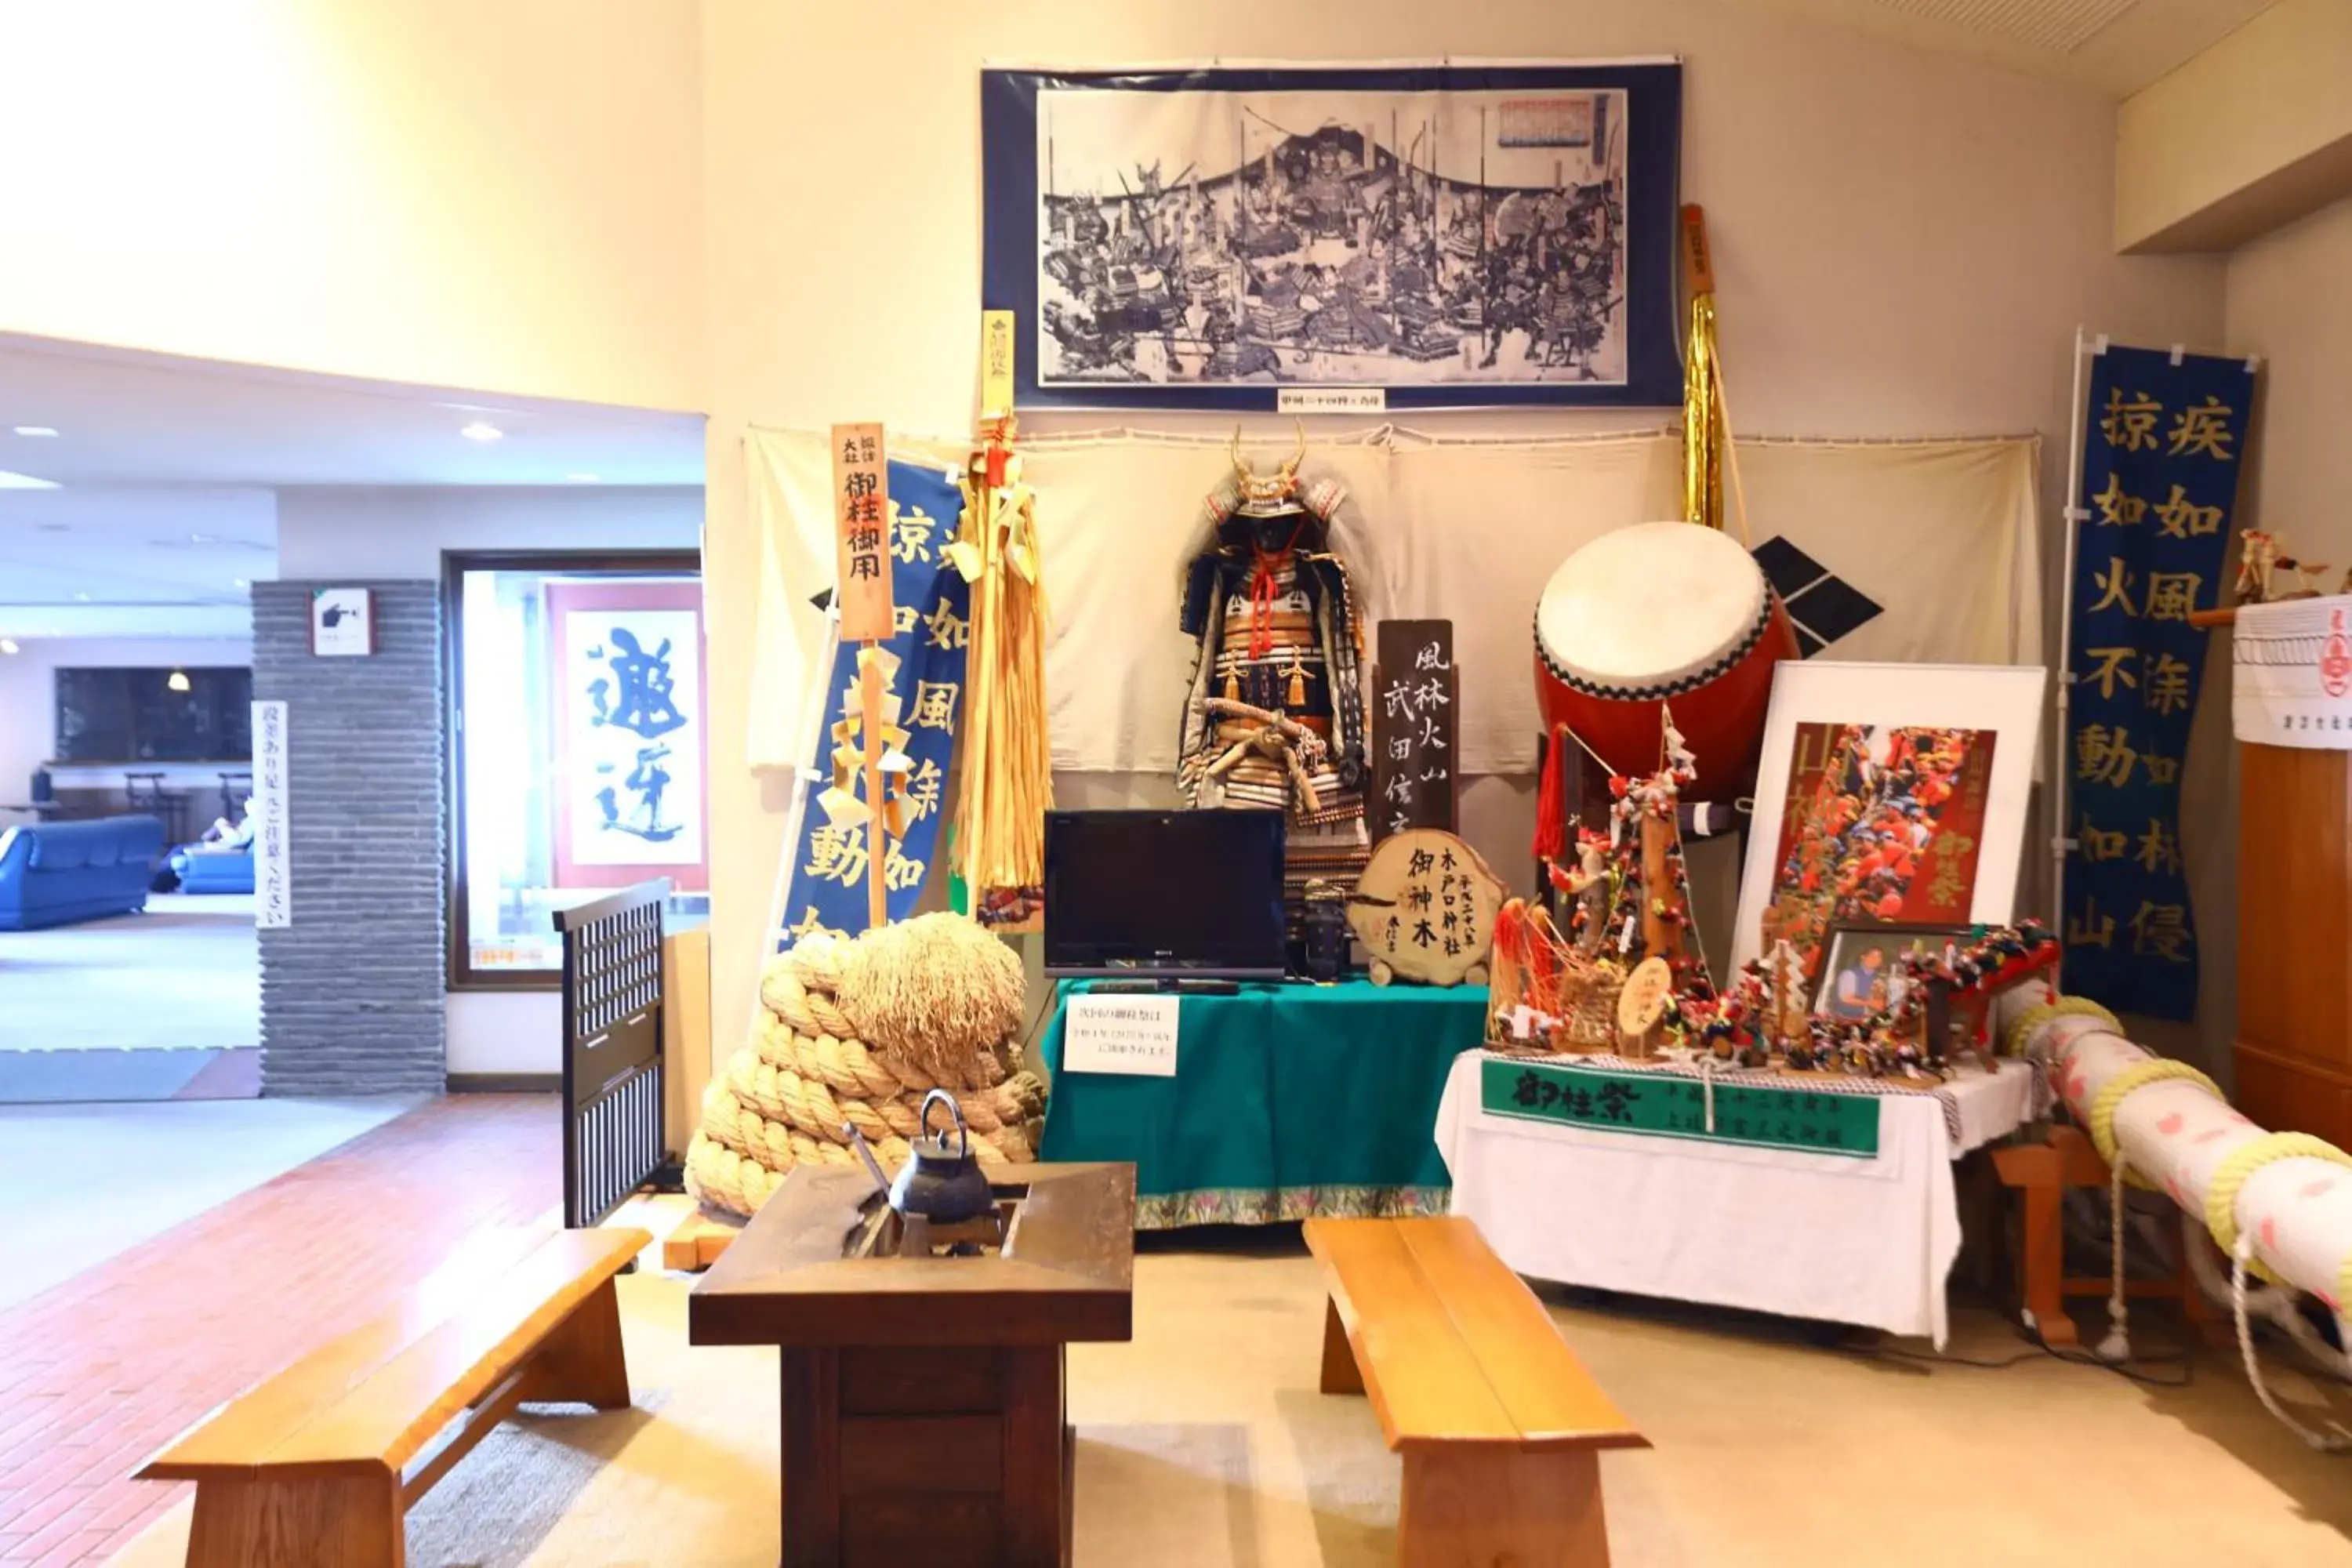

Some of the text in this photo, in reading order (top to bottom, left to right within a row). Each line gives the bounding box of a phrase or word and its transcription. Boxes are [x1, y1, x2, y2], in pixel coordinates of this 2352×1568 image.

[844, 470, 881, 582] 御柱御用
[1414, 640, 1450, 782] 風林火山
[1406, 847, 1438, 949] 御神木
